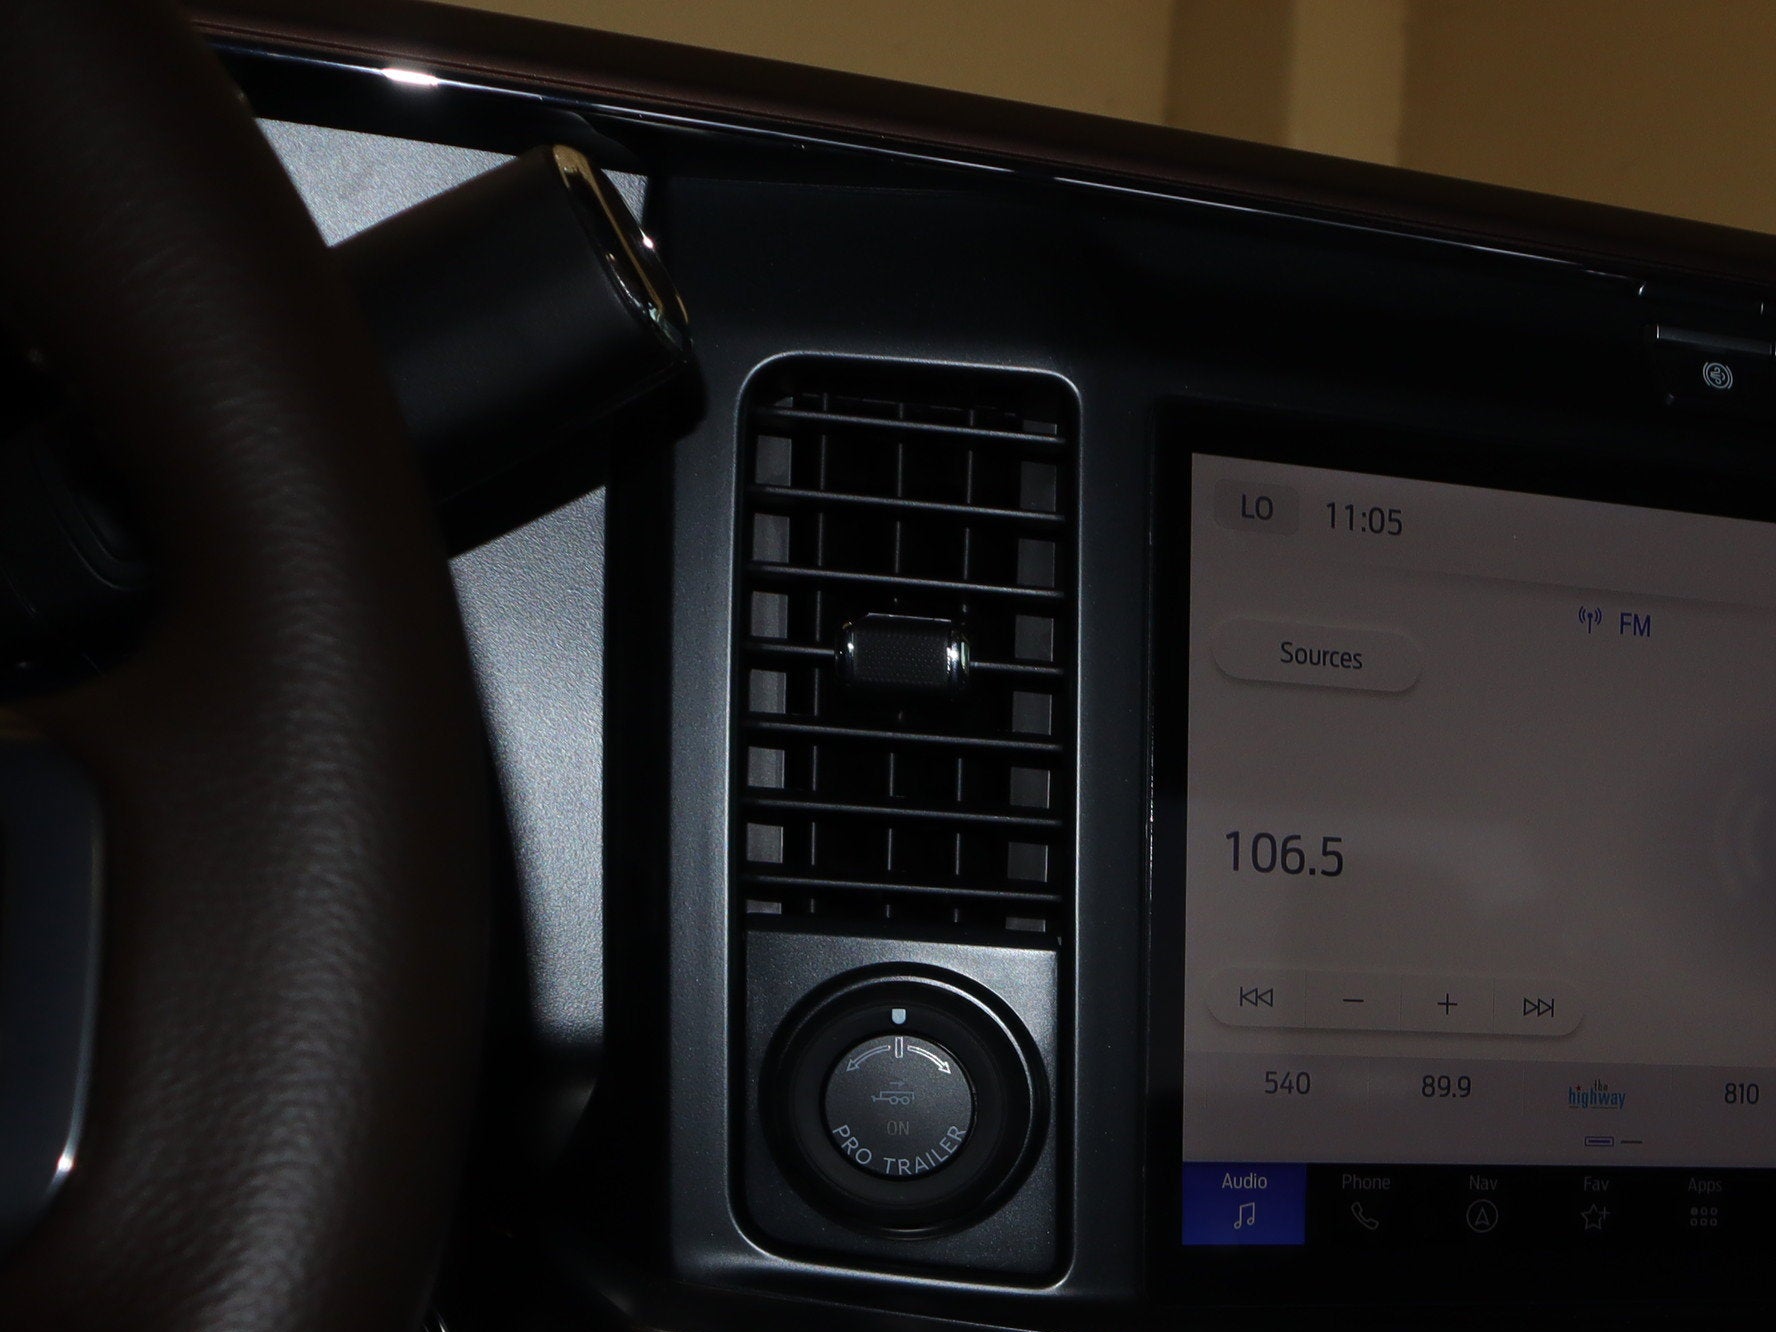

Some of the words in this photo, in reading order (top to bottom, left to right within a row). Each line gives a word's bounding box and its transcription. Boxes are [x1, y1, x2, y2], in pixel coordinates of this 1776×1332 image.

[1240, 493, 1274, 521] LO
[1326, 501, 1403, 535] 11:05
[1619, 612, 1652, 637] FM
[1280, 642, 1363, 670] Sources
[1225, 831, 1343, 877] 106.5
[1264, 1071, 1311, 1094] 540
[1421, 1075, 1472, 1098] 89.9
[1724, 1083, 1760, 1105] 810
[1568, 1084, 1626, 1110] highway
[886, 1120, 910, 1136] ON
[832, 1124, 873, 1166] PRO
[882, 1124, 968, 1176] TRAILER
[1221, 1173, 1268, 1190] Audio
[1341, 1174, 1392, 1191] Phone
[1468, 1175, 1499, 1191] Nav
[1583, 1175, 1609, 1191] Fav
[1687, 1176, 1724, 1194] Apps
